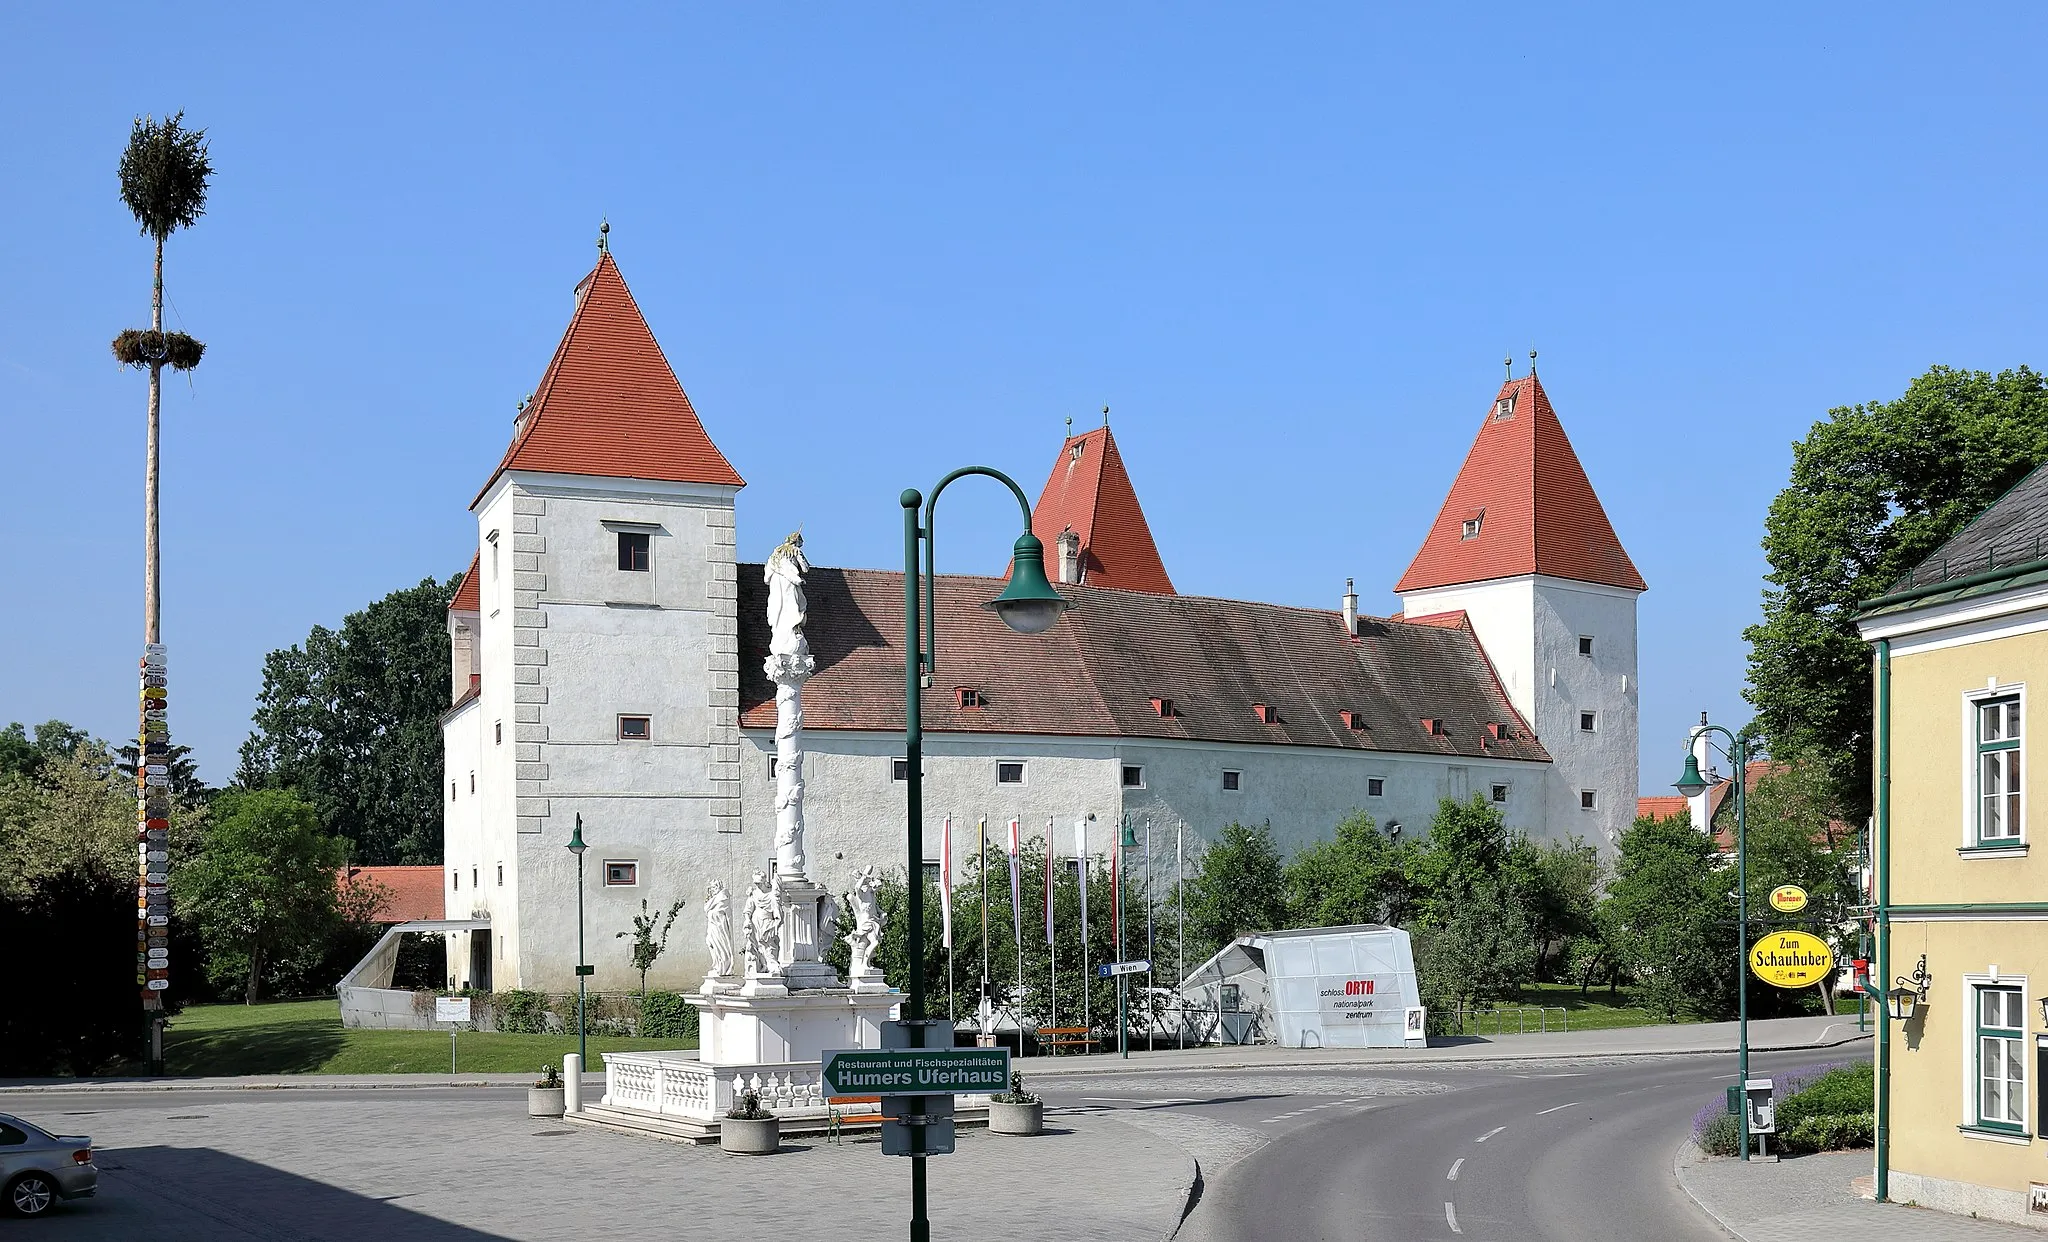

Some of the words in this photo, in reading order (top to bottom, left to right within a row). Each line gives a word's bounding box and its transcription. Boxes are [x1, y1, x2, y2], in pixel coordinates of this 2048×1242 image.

[1779, 937, 1800, 949] Zum
[1756, 951, 1828, 967] Schauhuber
[1103, 967, 1108, 975] 3
[1320, 988, 1345, 997] schloss
[1345, 980, 1374, 995] ORTH
[1333, 1000, 1374, 1009] nationalpark
[1345, 1011, 1373, 1019] zentrum
[838, 1060, 892, 1069] Restaurant
[894, 1059, 912, 1068] und
[915, 1058, 1003, 1069] Fischspezialitäten
[838, 1070, 912, 1086] Humers
[918, 1069, 1004, 1085] Uferhaus
